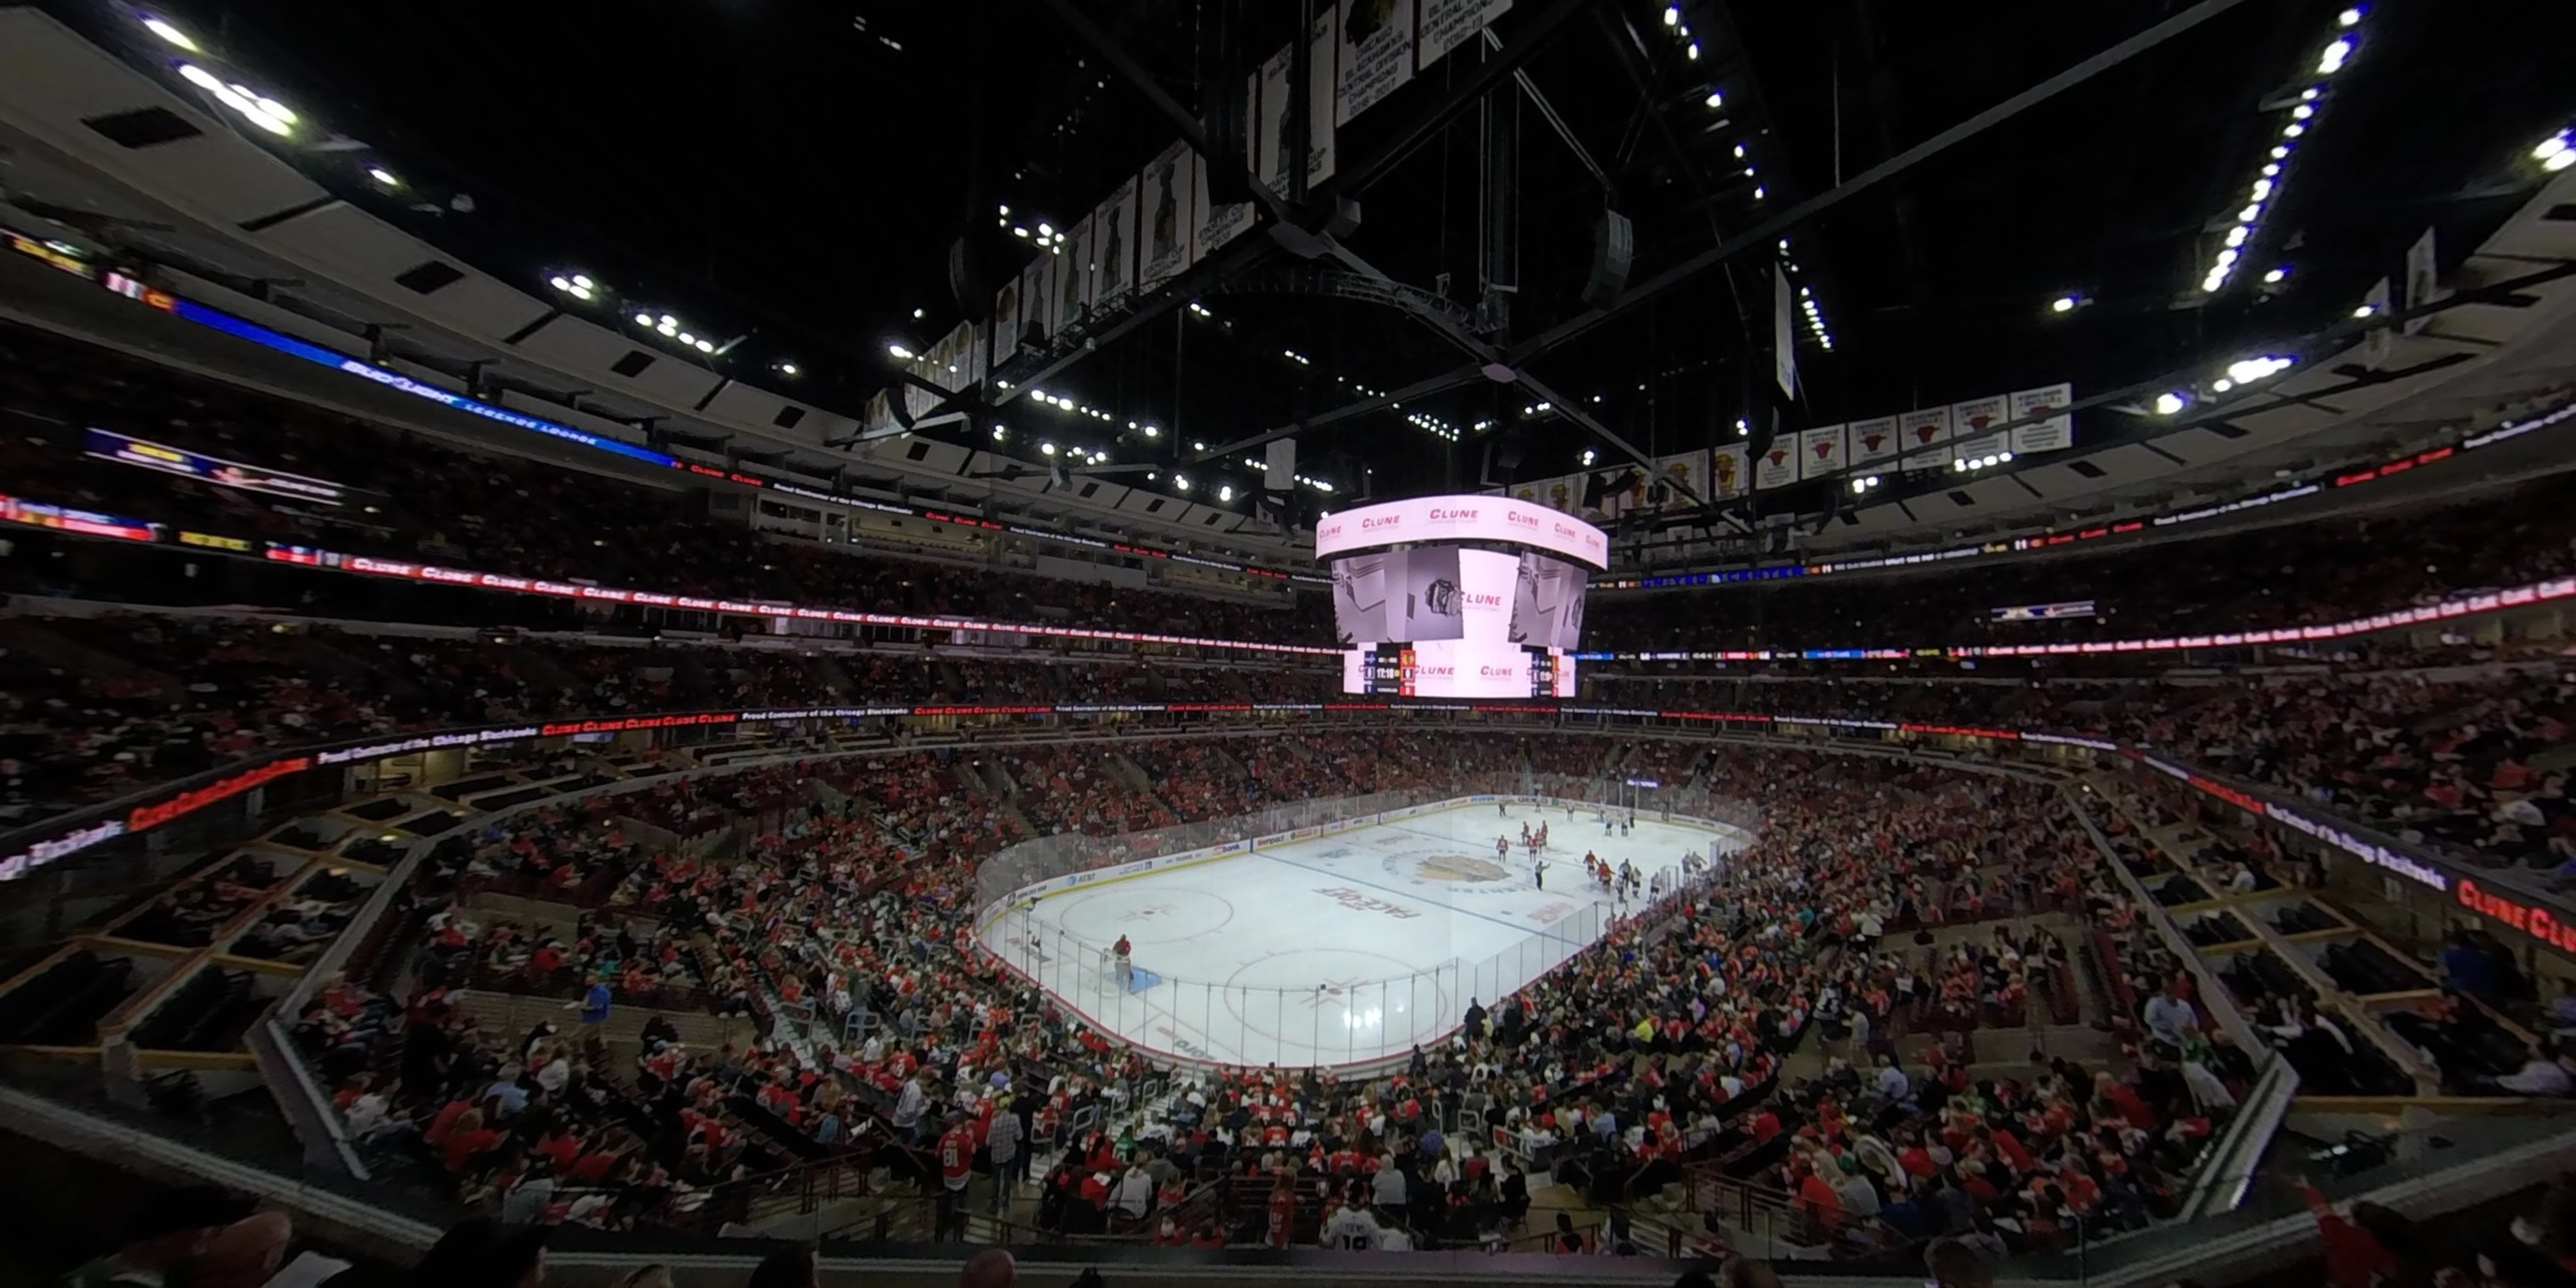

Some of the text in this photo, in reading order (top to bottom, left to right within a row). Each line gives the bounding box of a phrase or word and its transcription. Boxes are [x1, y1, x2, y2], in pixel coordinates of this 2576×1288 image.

[1362, 516, 1401, 529] CLUNE
[1430, 509, 1479, 519] CLUNE
[1507, 511, 1539, 526] CLUNE
[1554, 523, 1575, 538] CLUNE
[1480, 665, 1513, 676] CLUNE
[582, 720, 624, 732] CLUNE
[663, 716, 697, 725] CLUNE
[698, 714, 736, 723] CLUNE
[2458, 880, 2576, 954] CLUNE CLU
